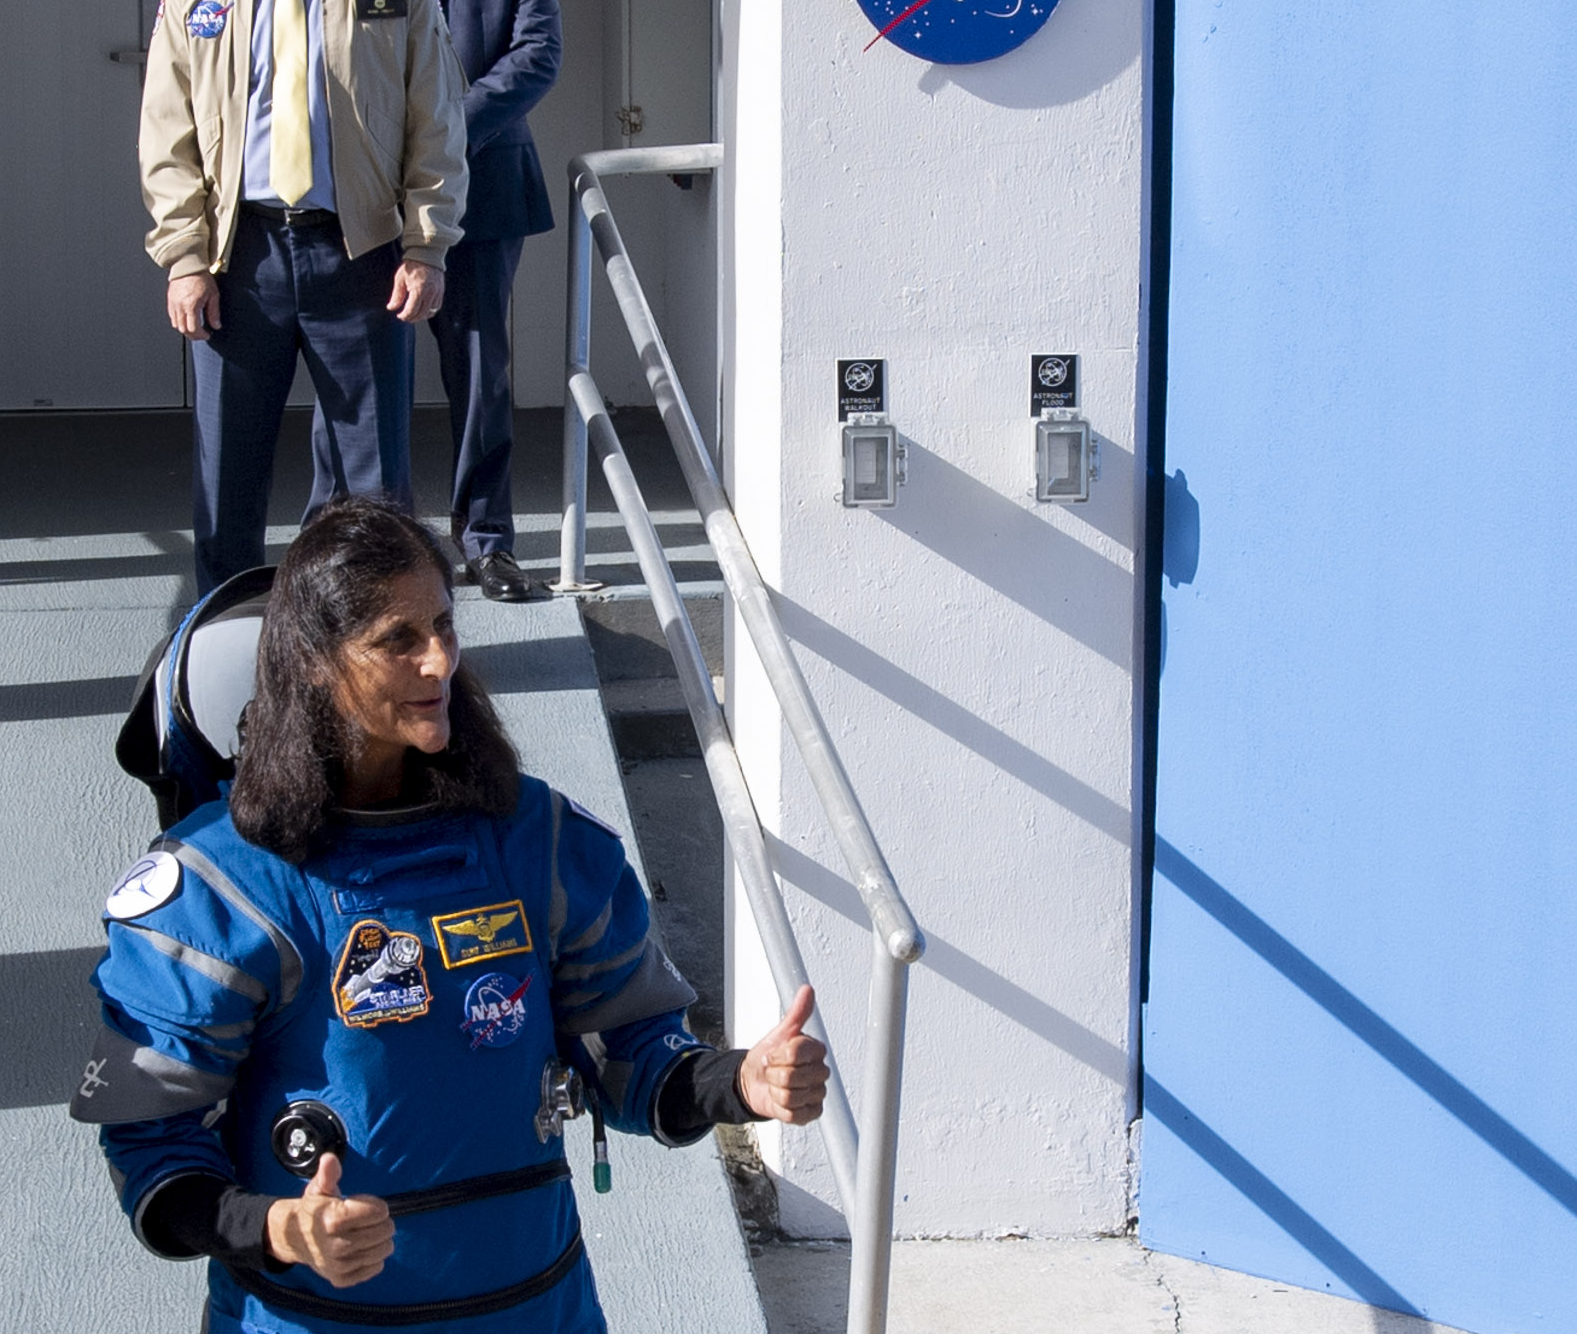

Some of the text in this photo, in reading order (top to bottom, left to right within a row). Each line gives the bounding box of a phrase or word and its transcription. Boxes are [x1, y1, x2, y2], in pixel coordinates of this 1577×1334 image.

[1033, 392, 1073, 400] ASTRONAUT
[840, 397, 881, 405] ASTRONAUT
[471, 998, 526, 1022] NASA
